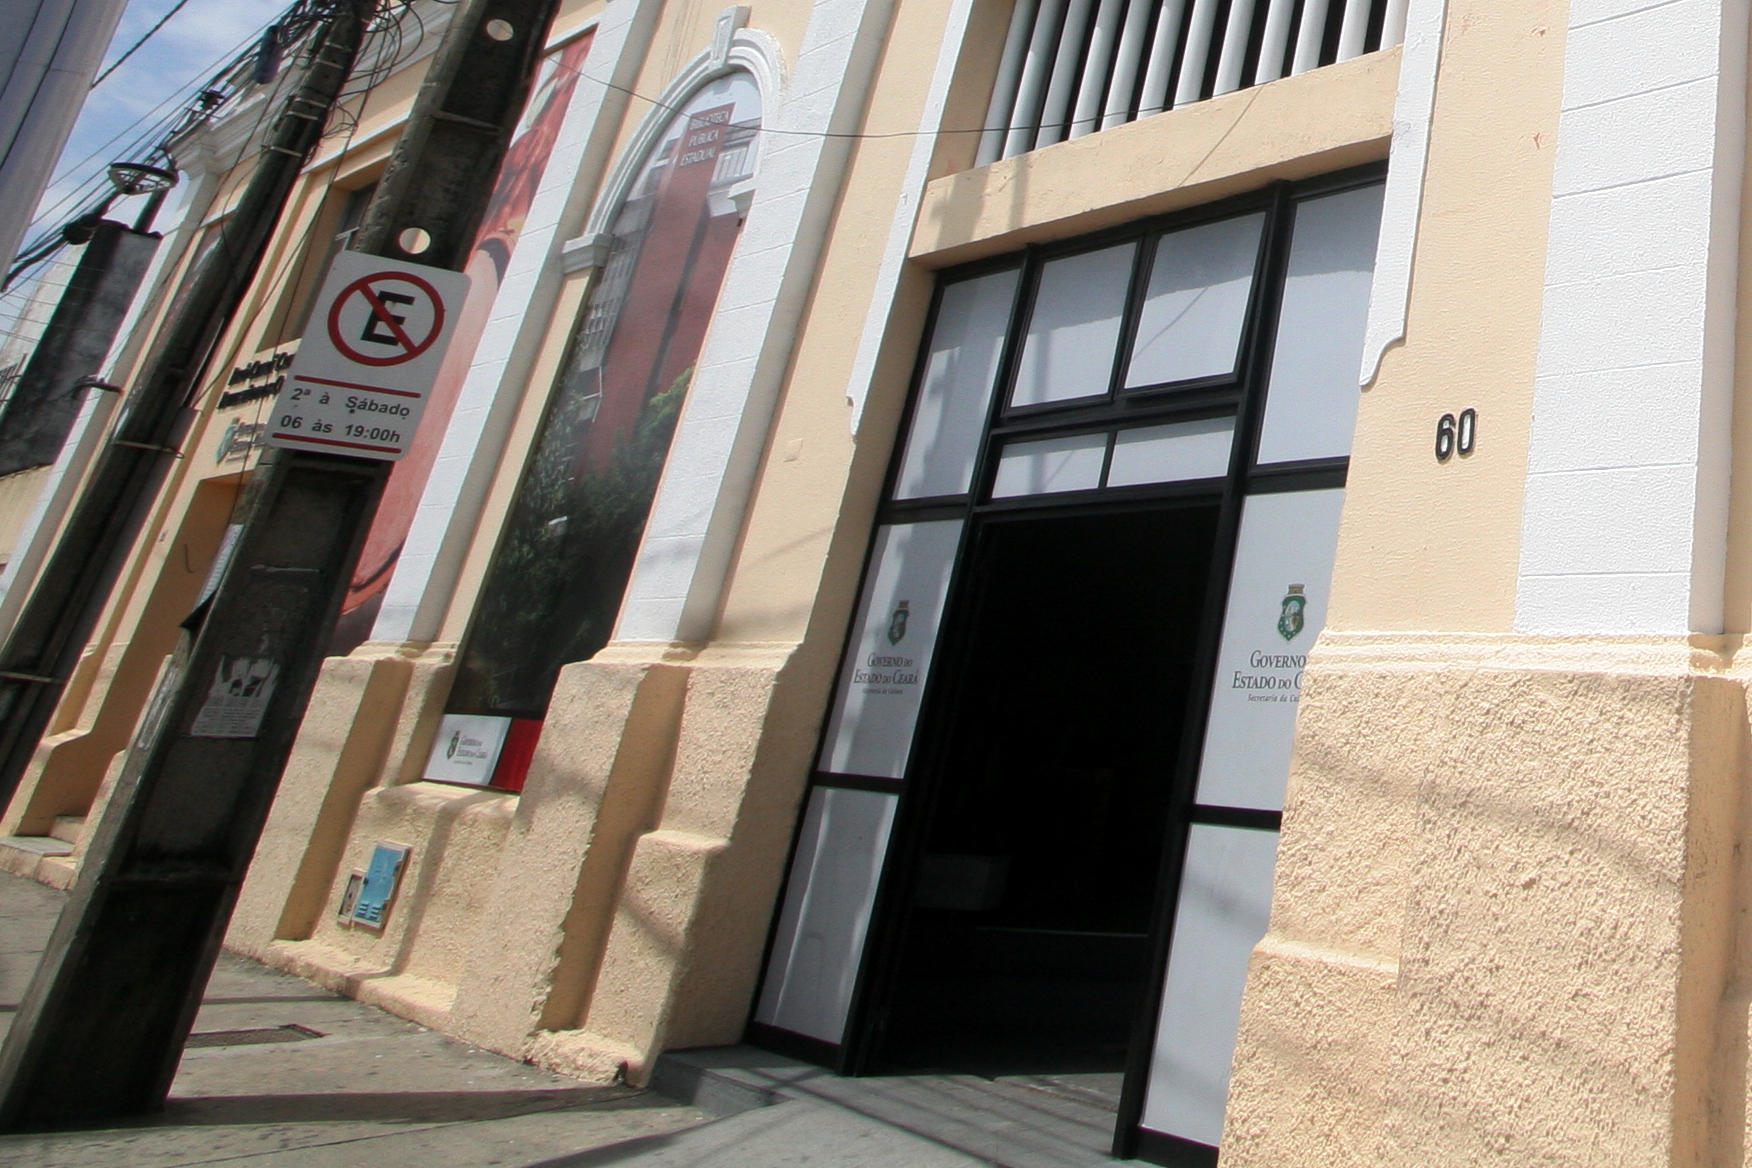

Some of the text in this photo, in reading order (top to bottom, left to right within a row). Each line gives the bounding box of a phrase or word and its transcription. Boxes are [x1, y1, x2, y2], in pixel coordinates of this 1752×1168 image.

[319, 391, 330, 405] à
[345, 395, 410, 417] Sábado
[280, 414, 303, 430] 06
[311, 418, 333, 434] às
[345, 423, 400, 444] 19:00h
[1435, 407, 1476, 461] 60
